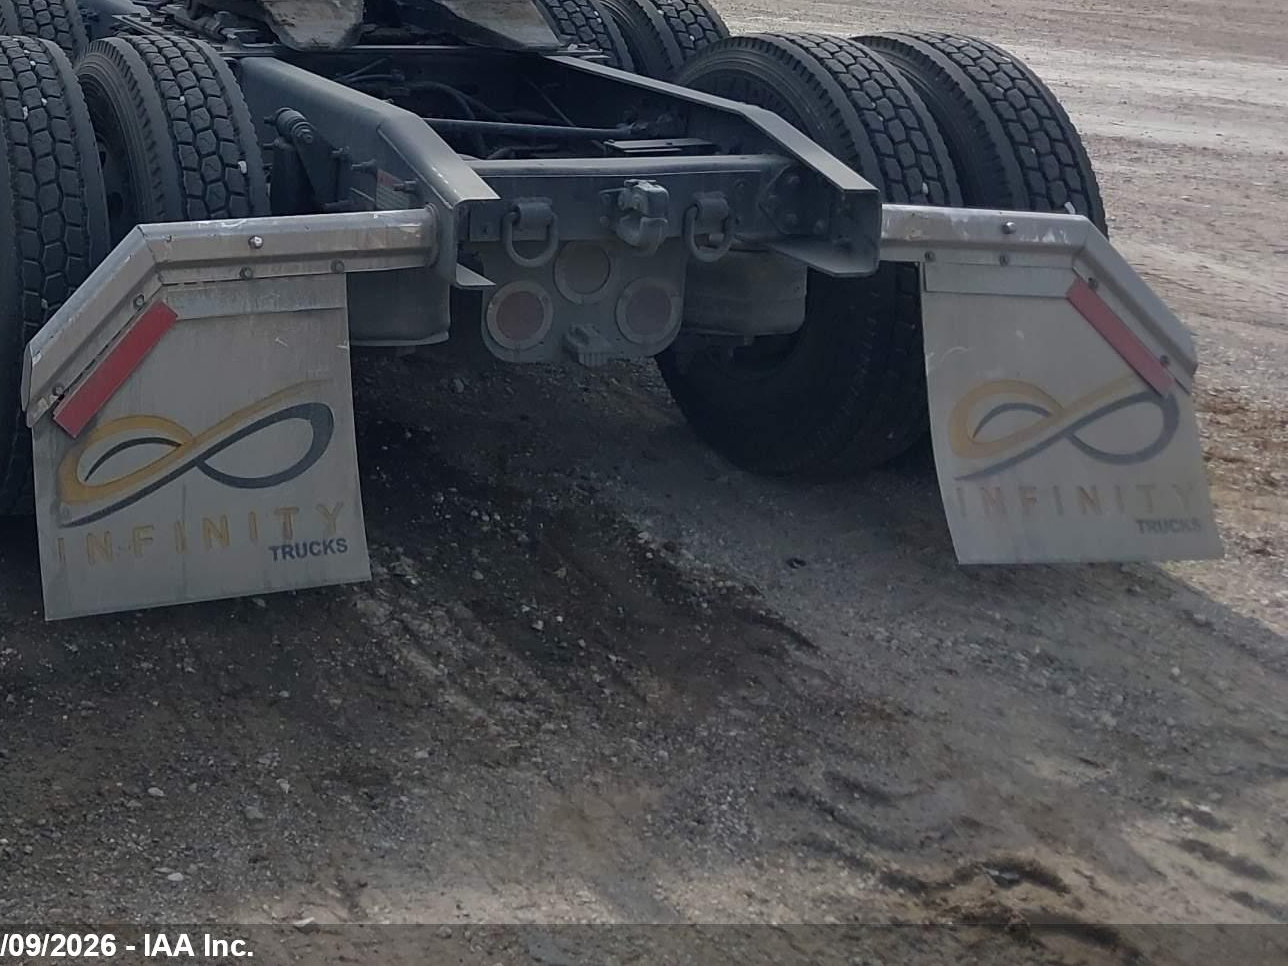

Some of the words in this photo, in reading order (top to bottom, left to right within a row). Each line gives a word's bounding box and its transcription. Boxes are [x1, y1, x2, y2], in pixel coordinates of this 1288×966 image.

[955, 484, 1194, 518] INFINITY
[56, 502, 344, 564] INFINITY
[1135, 518, 1202, 534] TRUCKS
[268, 537, 349, 562] TRUCKS
